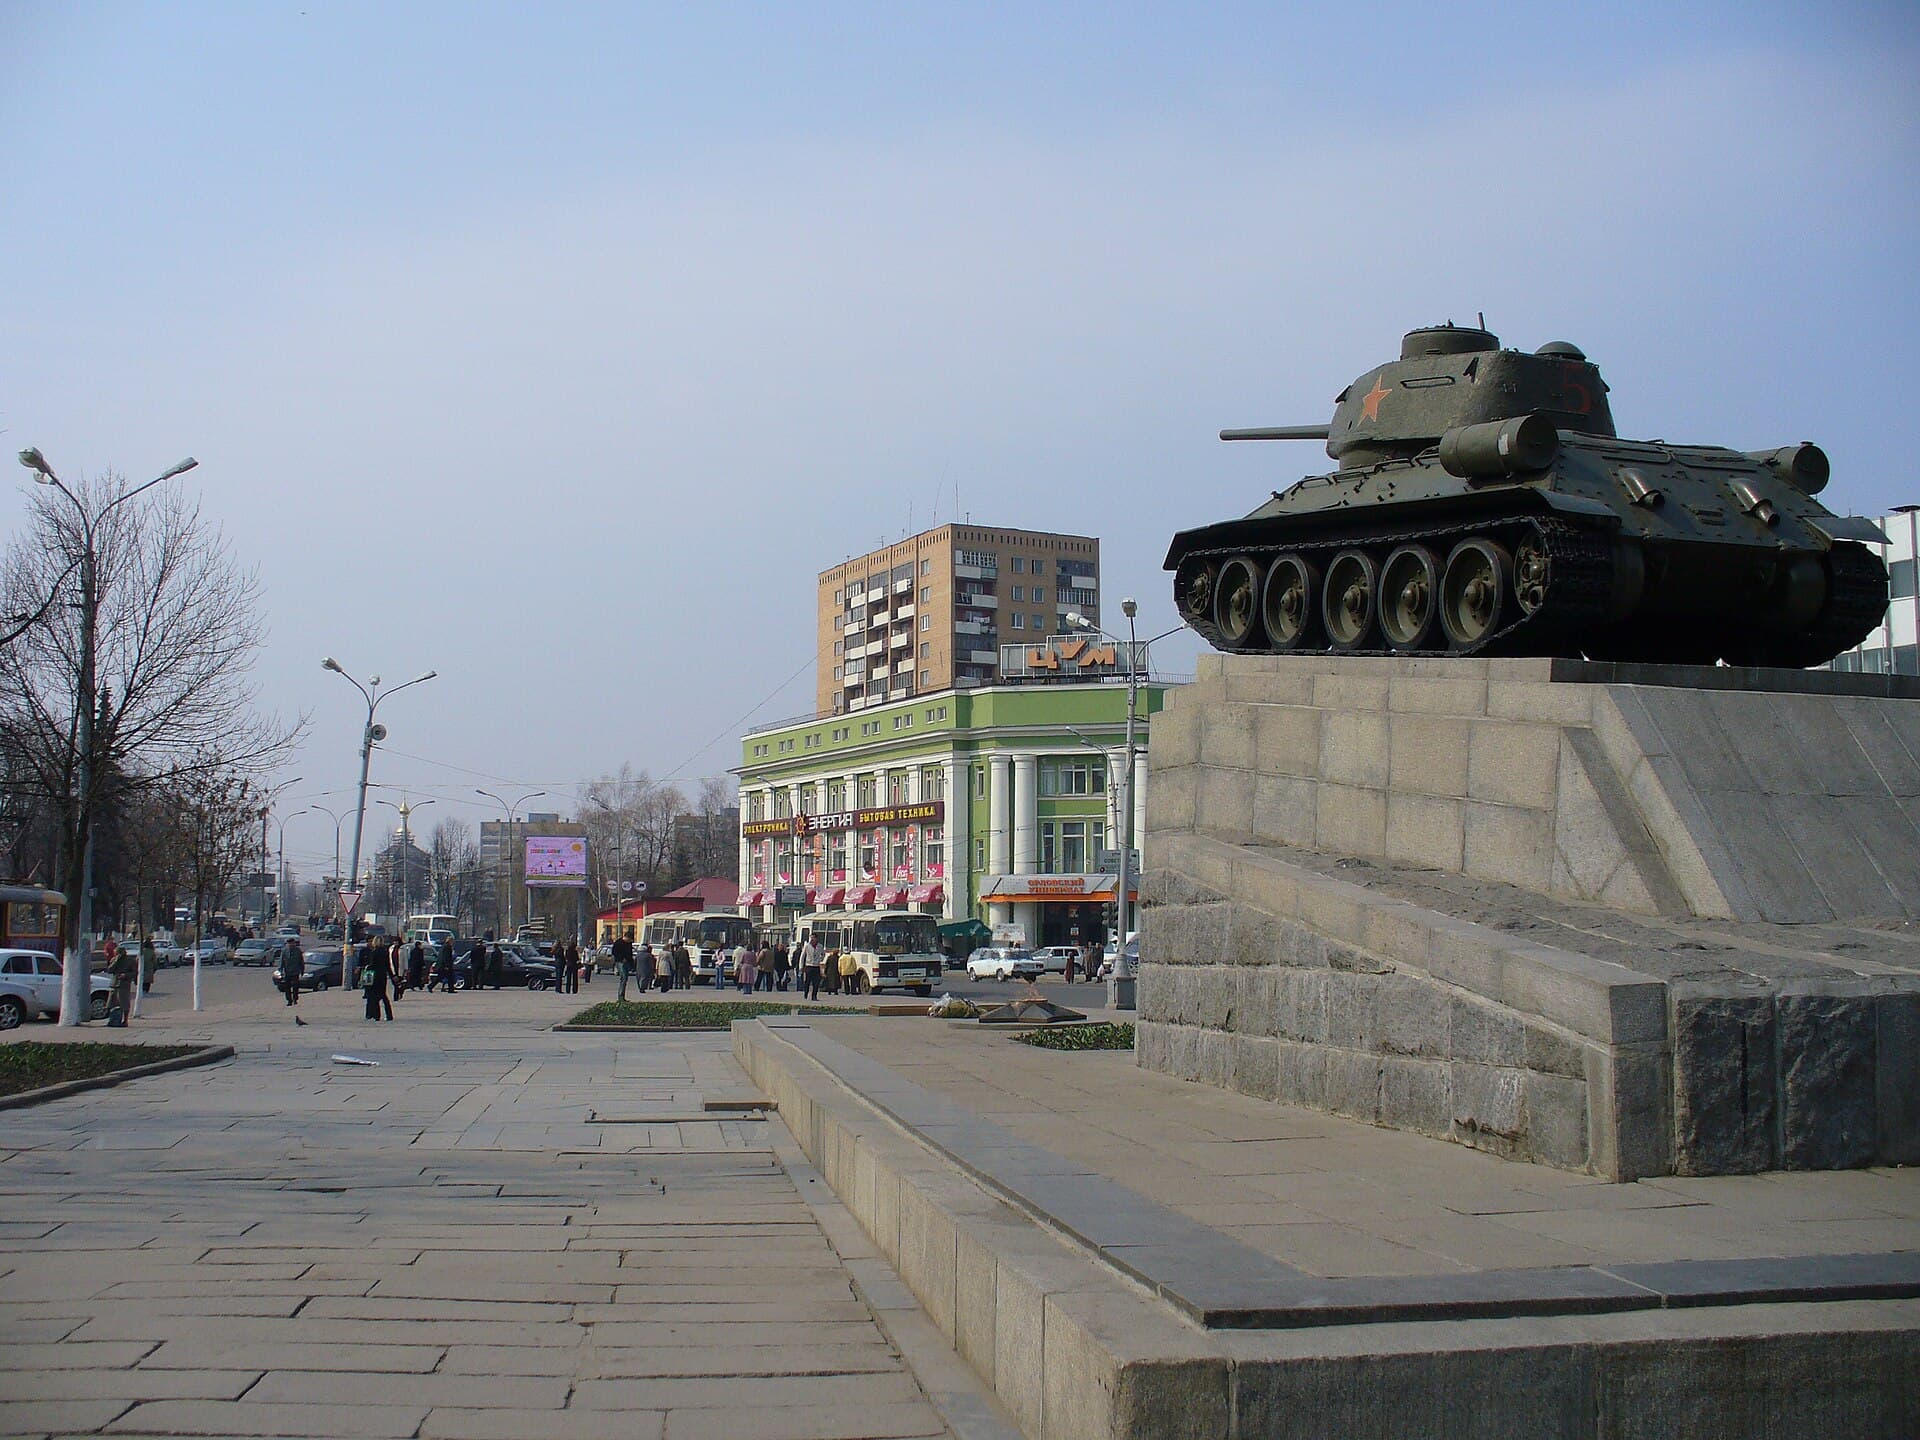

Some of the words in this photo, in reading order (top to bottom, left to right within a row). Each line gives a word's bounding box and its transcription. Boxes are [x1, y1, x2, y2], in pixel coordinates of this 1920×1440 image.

[1564, 363, 1592, 412] 5
[1027, 640, 1115, 669] ЦУМ
[808, 814, 853, 830] ЭНЕРГИЯ
[859, 810, 895, 823] БЫТОВАЯ
[898, 806, 936, 820] ТЕХНИКА
